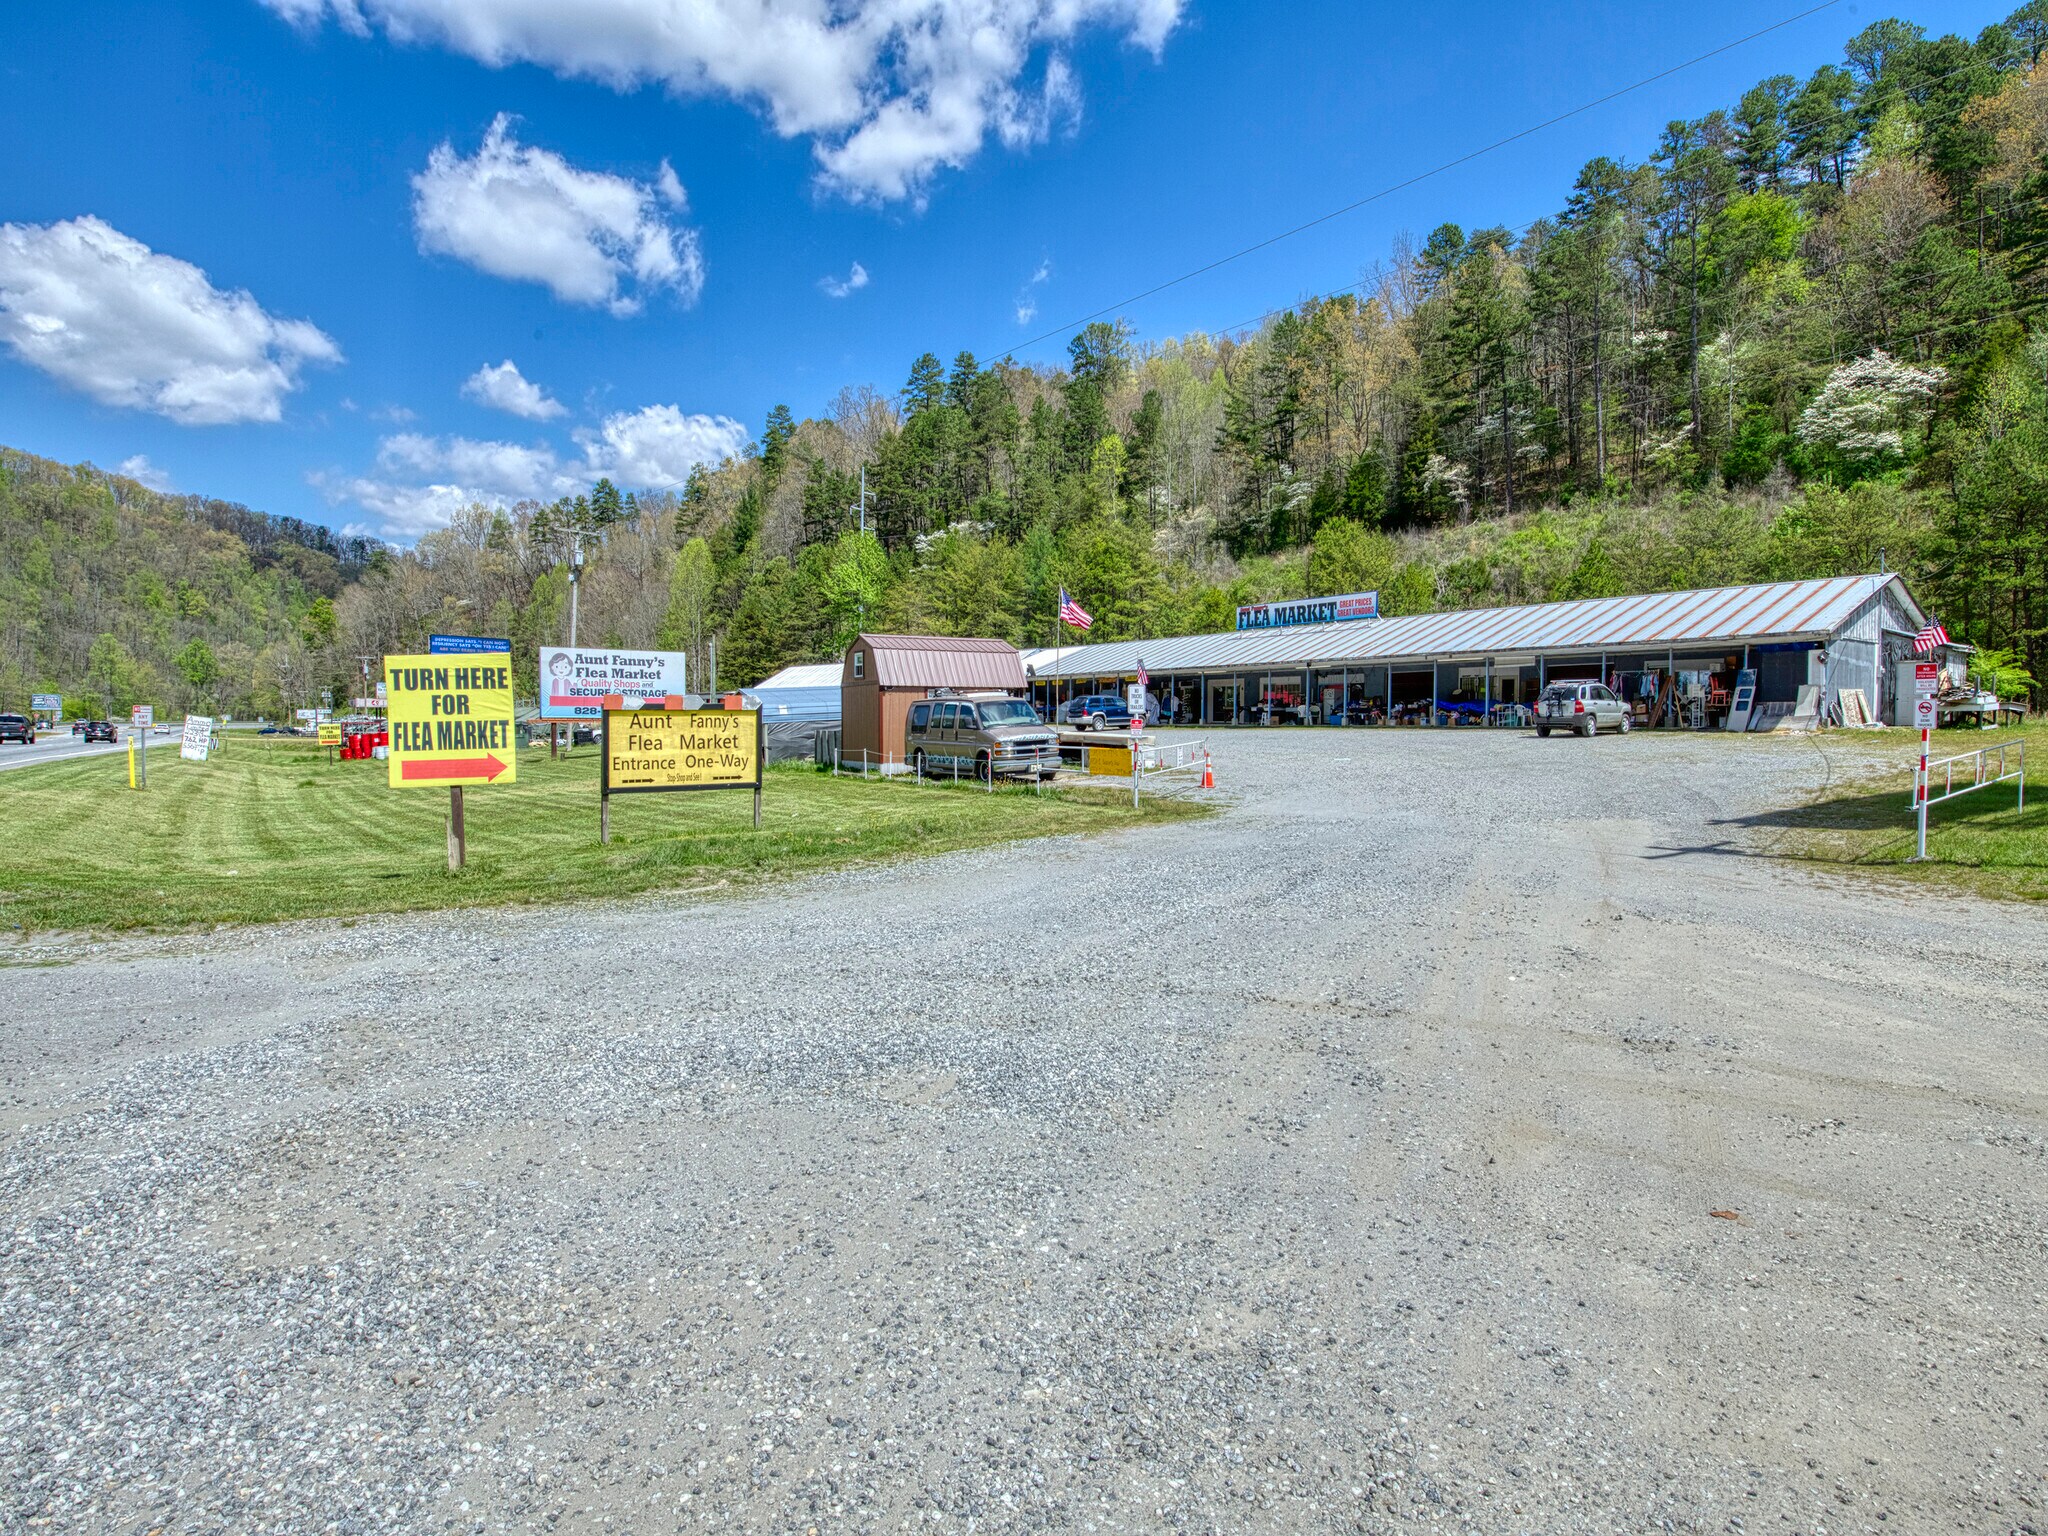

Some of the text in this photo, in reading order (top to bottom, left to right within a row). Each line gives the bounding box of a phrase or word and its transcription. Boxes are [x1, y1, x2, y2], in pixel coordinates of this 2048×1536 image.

[1337, 606, 1374, 617] GREAT VENDORS
[1339, 598, 1372, 608] GREAT PRICES
[1239, 602, 1337, 628] FLEA MARKET
[575, 654, 665, 671] Aunt Fanny's
[390, 667, 450, 692] TURN
[454, 667, 509, 690] HERE
[575, 666, 662, 680] Flea Market
[570, 687, 668, 698] SECURE STORAGE
[581, 678, 613, 689] Quality
[613, 679, 641, 689] Shops
[431, 693, 470, 716] FOR
[629, 712, 739, 733] Aunt Fanny's
[393, 719, 510, 752] FLEA MARKET
[628, 733, 739, 751] Flea Market
[612, 753, 749, 772] Entrance One-Way
